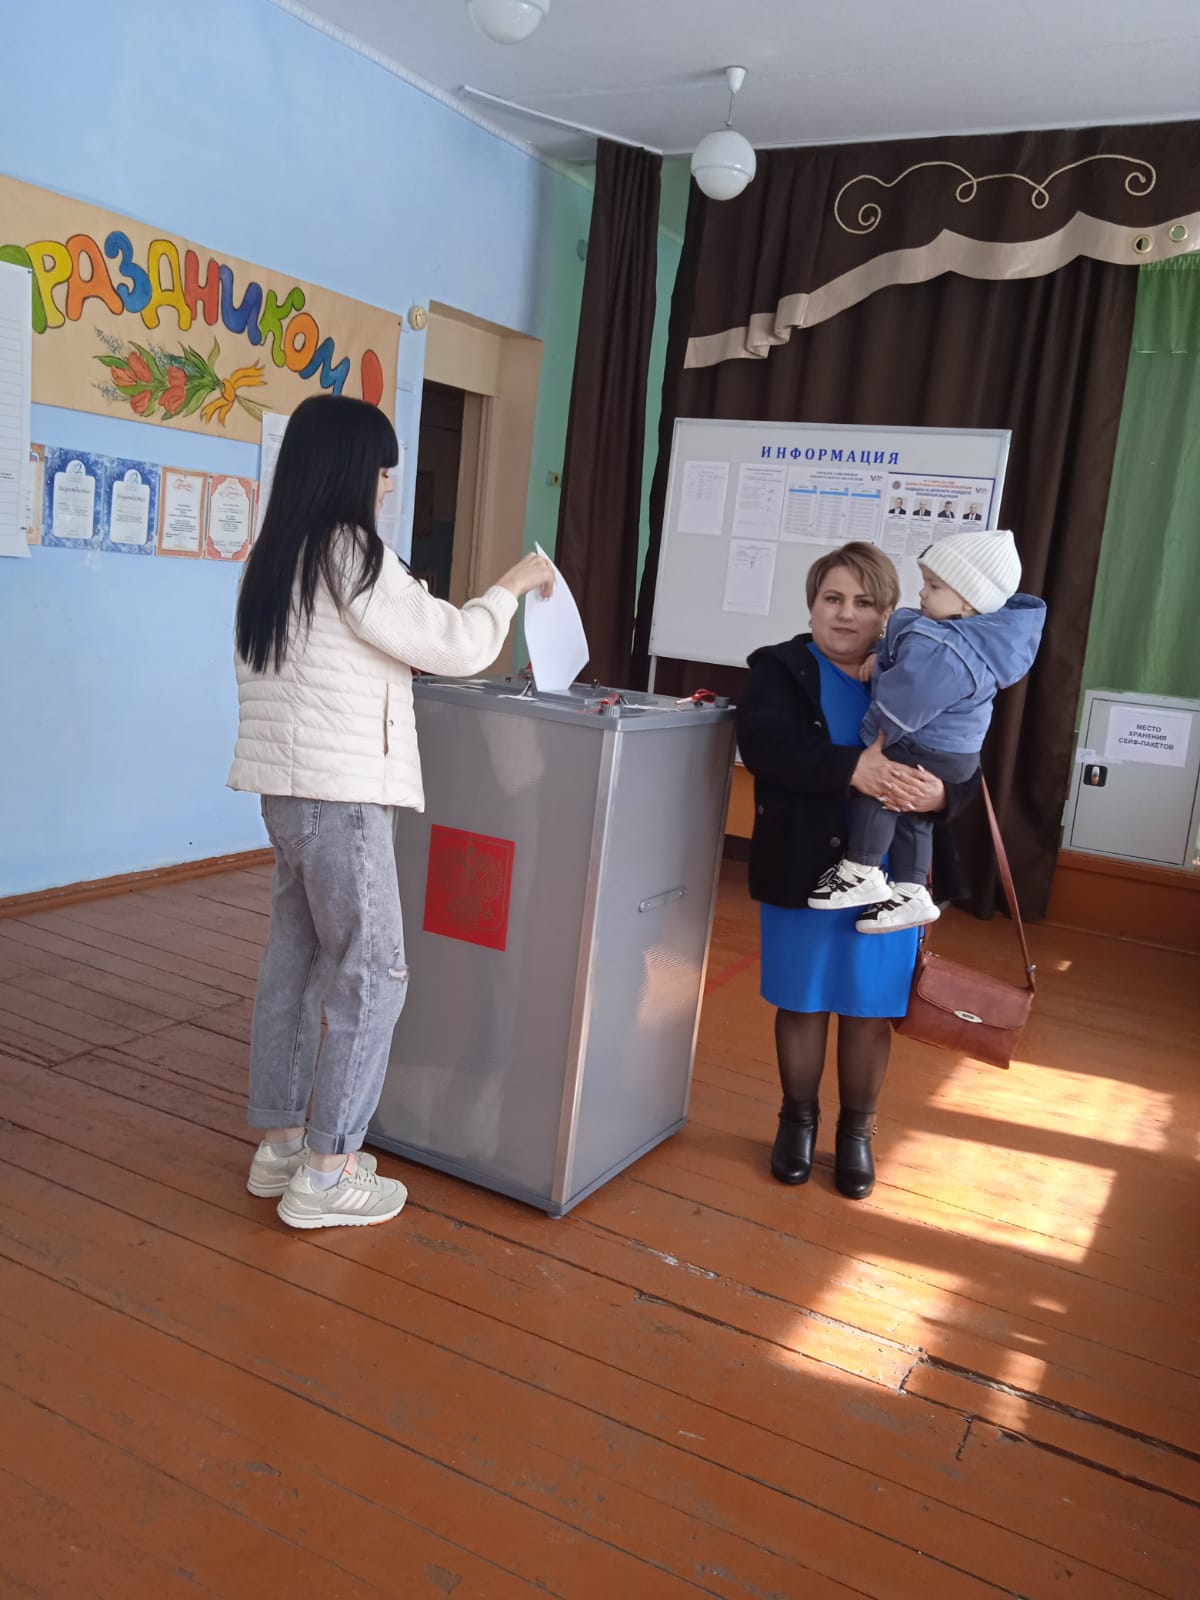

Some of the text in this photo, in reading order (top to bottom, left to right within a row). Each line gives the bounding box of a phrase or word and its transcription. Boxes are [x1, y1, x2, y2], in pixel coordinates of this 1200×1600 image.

[760, 446, 900, 466] ИНФОРМАЦИЯ
[1136, 723, 1162, 732] МЕСТО
[1127, 731, 1167, 741] ХРАНЕНИЯ
[1118, 737, 1175, 751] СЕЙФ-ПАКЕТОВ
